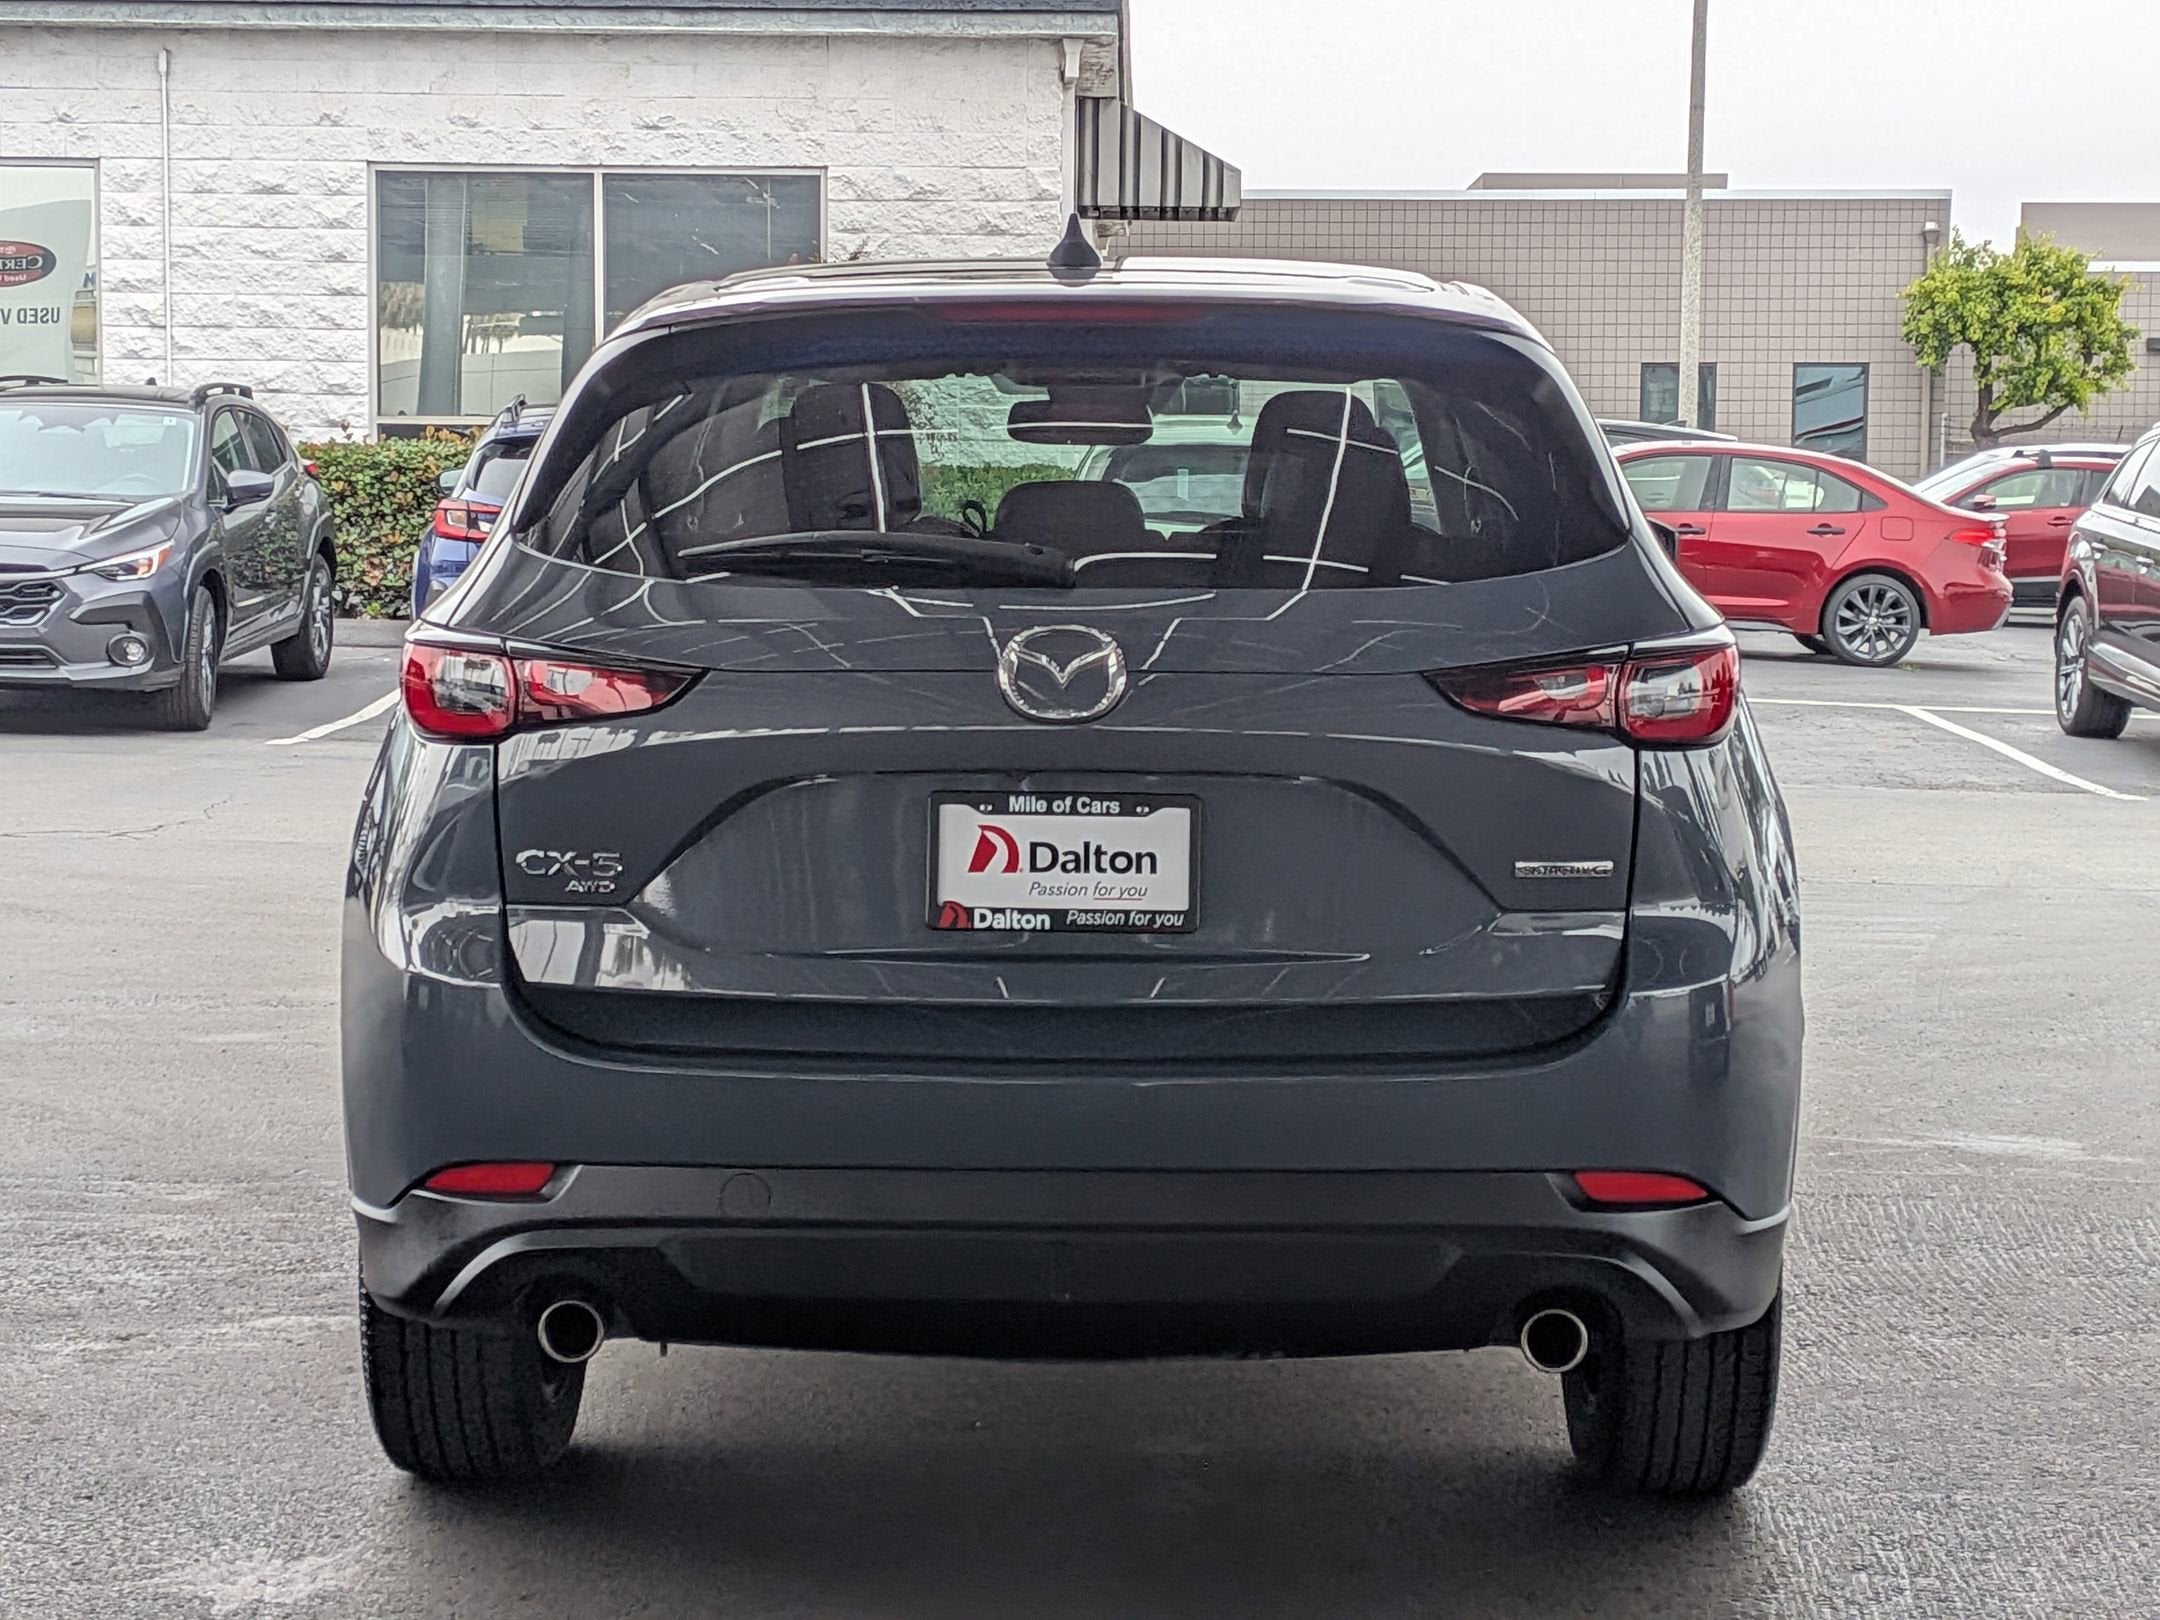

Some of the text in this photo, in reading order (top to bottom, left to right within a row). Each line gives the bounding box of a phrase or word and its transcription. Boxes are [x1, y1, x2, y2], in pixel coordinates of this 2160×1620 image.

[1008, 796, 1120, 814] Mile of Cars
[516, 849, 623, 876] CX-5
[1029, 841, 1157, 875] Dalton
[565, 880, 615, 893] AWD
[1028, 881, 1148, 899] Passion for you
[973, 909, 1184, 930] Dalton Passion for you
